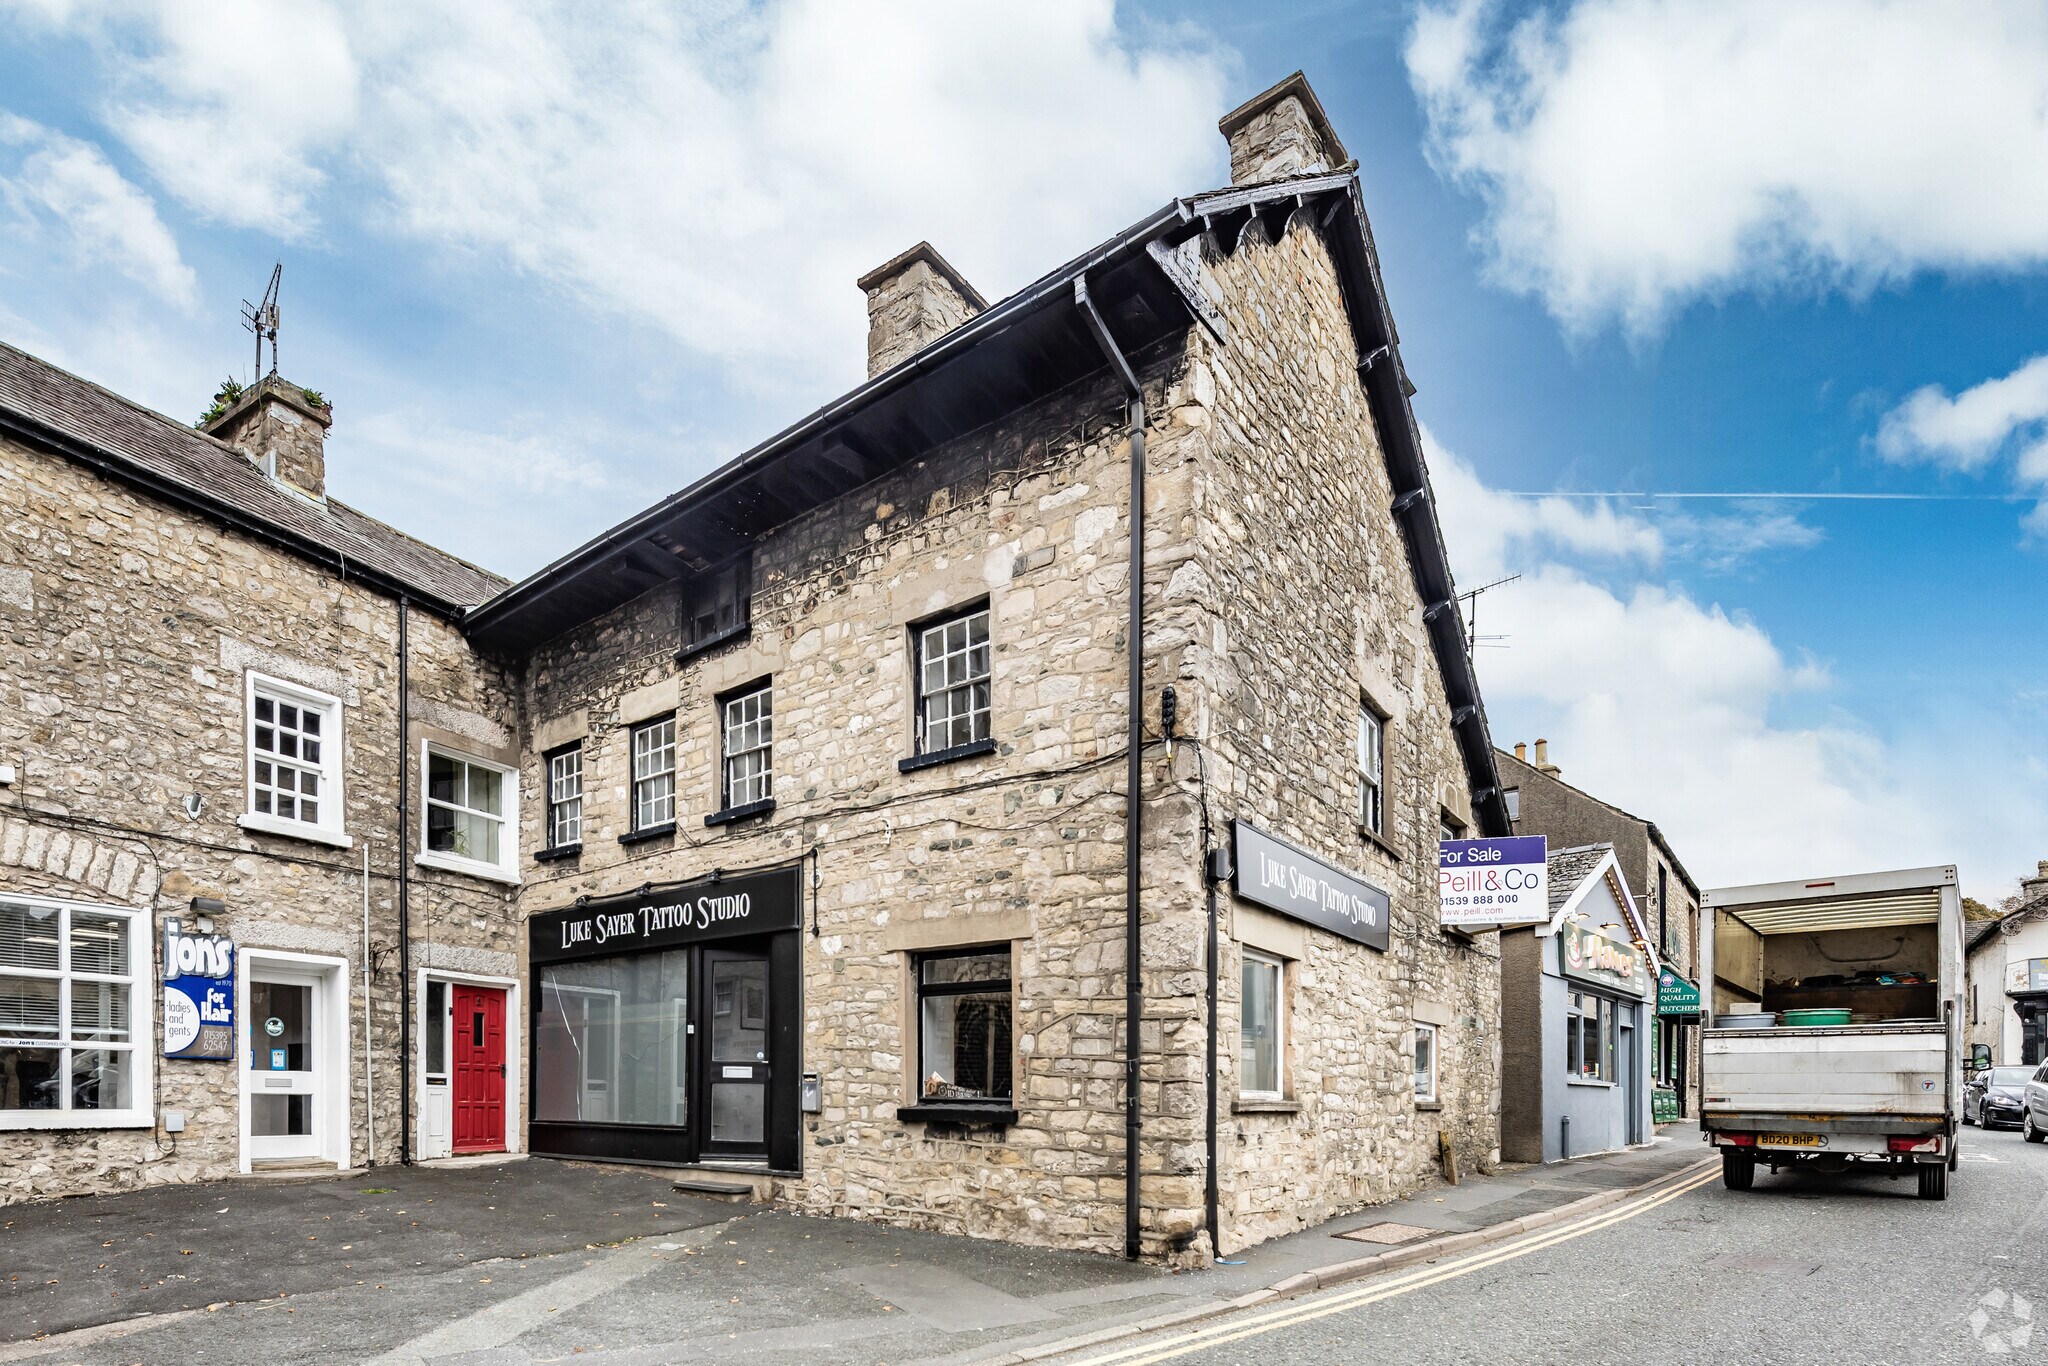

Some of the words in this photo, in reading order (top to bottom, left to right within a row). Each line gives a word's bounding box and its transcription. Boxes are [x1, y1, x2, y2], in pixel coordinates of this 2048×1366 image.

[1440, 849, 1463, 863] For
[1467, 847, 1502, 862] Sale
[1473, 895, 1493, 904] 888
[1497, 894, 1518, 904] 000
[167, 921, 233, 977] jon's
[207, 988, 226, 1003] for
[1661, 994, 1697, 1002] QUALITY
[168, 1000, 191, 1013] ladies
[200, 1001, 233, 1022] Hair
[169, 1012, 184, 1024] and
[169, 1025, 191, 1038] gents
[203, 1030, 228, 1040] 015395
[203, 1041, 228, 1051] 62547
[1761, 1135, 1790, 1144] BD20
[1792, 1136, 1814, 1145] BHP
